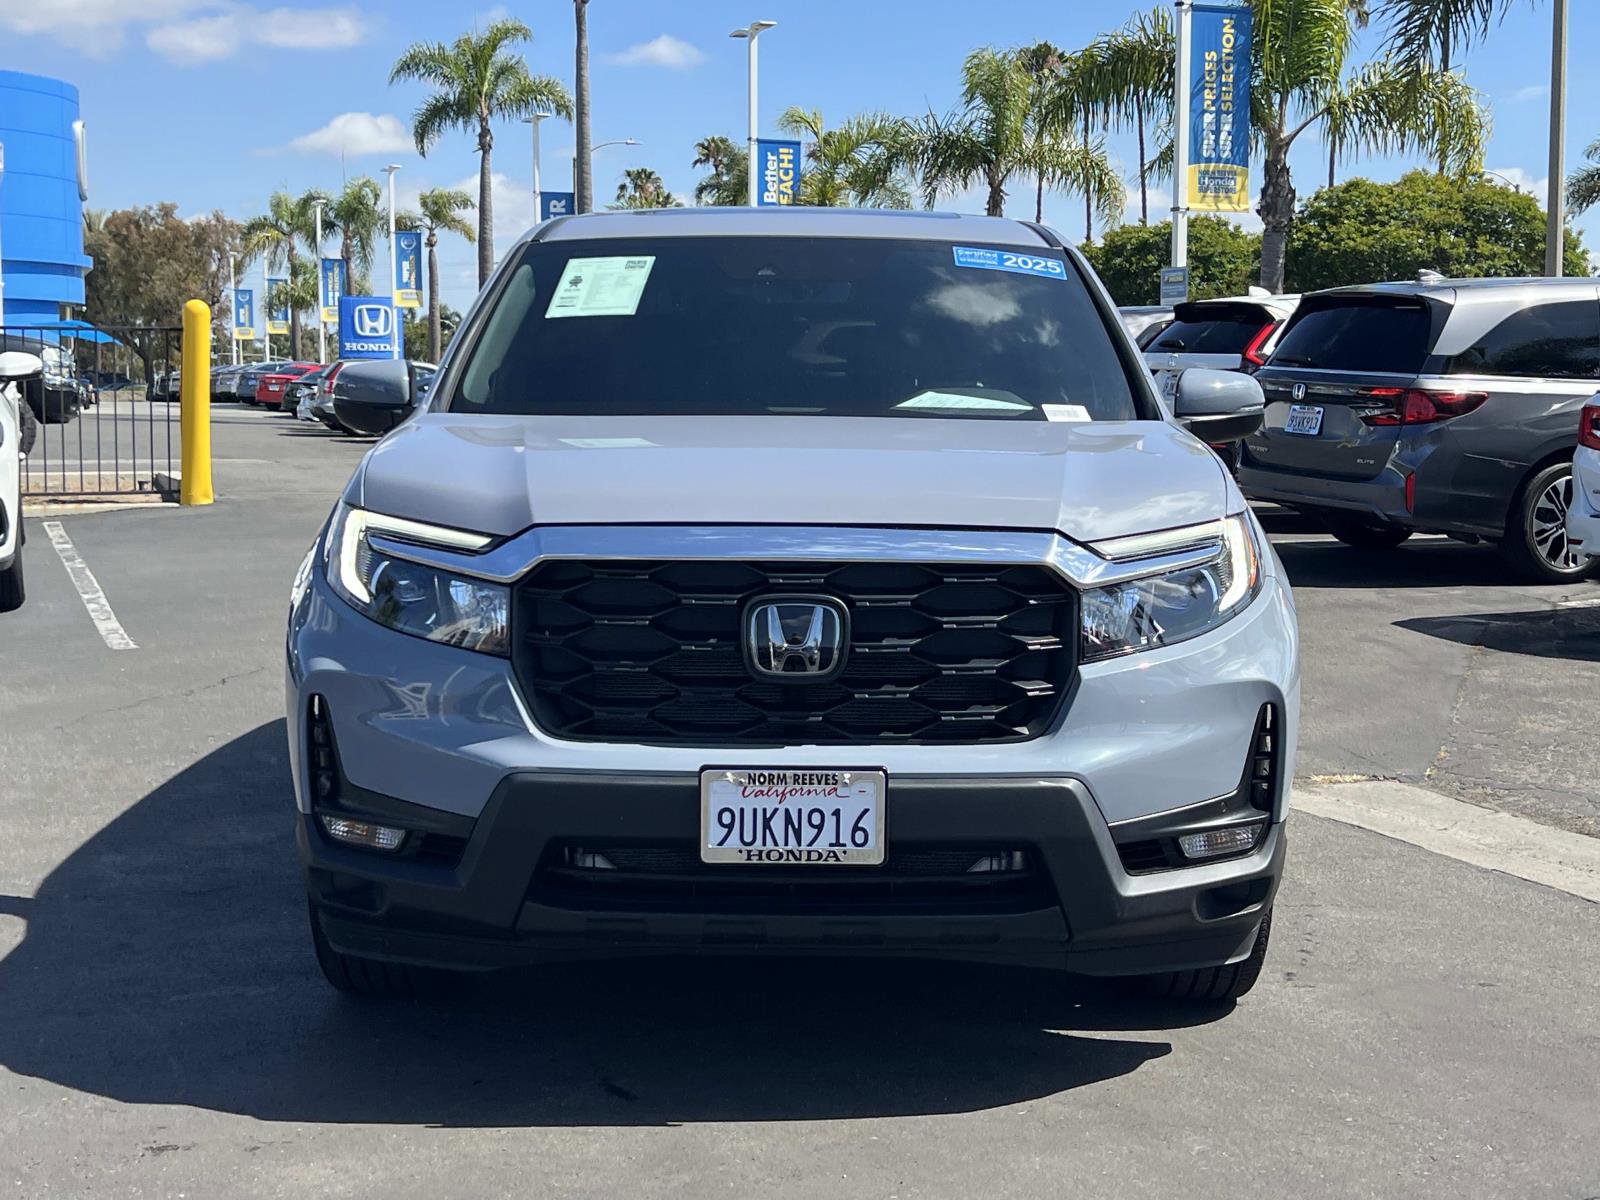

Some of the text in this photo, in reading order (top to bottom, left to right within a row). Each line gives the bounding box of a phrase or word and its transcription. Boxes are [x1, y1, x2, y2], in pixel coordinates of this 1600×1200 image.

[1219, 19, 1235, 158] SUPER SELECTION
[1203, 51, 1217, 158] SUPER PRICES
[763, 151, 778, 203] Better
[1200, 176, 1235, 186] Honda
[1003, 254, 1062, 274] 2025
[747, 772, 839, 786] NORM REEVES
[741, 785, 850, 805] California
[716, 806, 871, 848] 9UKN916
[744, 849, 843, 863] HONDA
